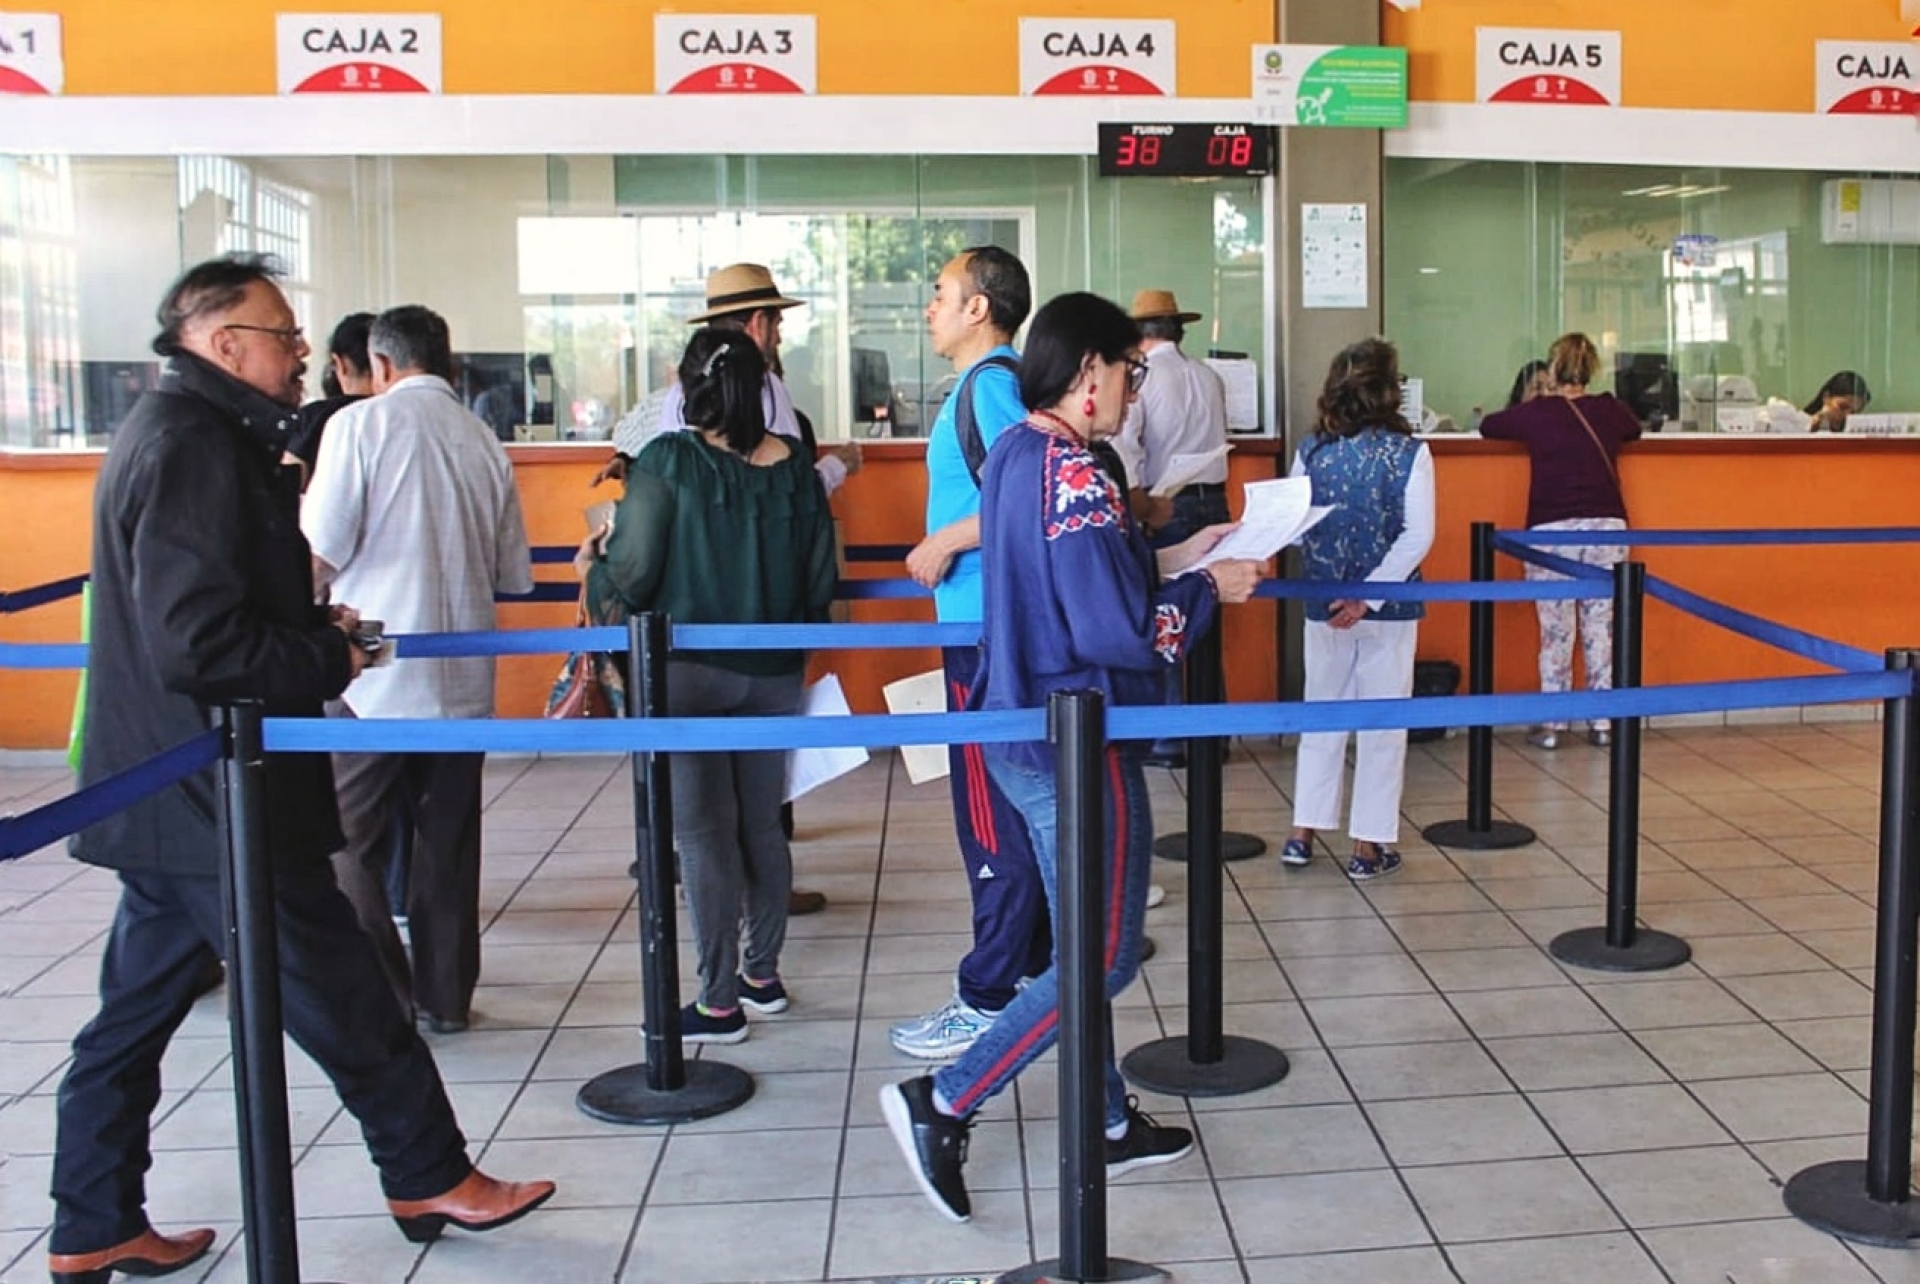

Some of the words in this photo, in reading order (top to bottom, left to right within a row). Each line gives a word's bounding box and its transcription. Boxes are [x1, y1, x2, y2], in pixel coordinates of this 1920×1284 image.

[22, 29, 37, 53] 1
[302, 28, 392, 53] CAJA
[400, 28, 418, 53] 2
[679, 29, 768, 54] CAJA
[775, 30, 792, 54] 3
[1043, 32, 1129, 57] CAJA
[1135, 33, 1155, 57] 4
[1499, 41, 1579, 67] CAJA
[1586, 44, 1602, 68] 5
[1836, 55, 1911, 79] CAJA
[1132, 124, 1175, 136] TURNO
[1214, 125, 1247, 136] CAJA
[1117, 136, 1161, 166] 38
[1207, 137, 1253, 166] 08
